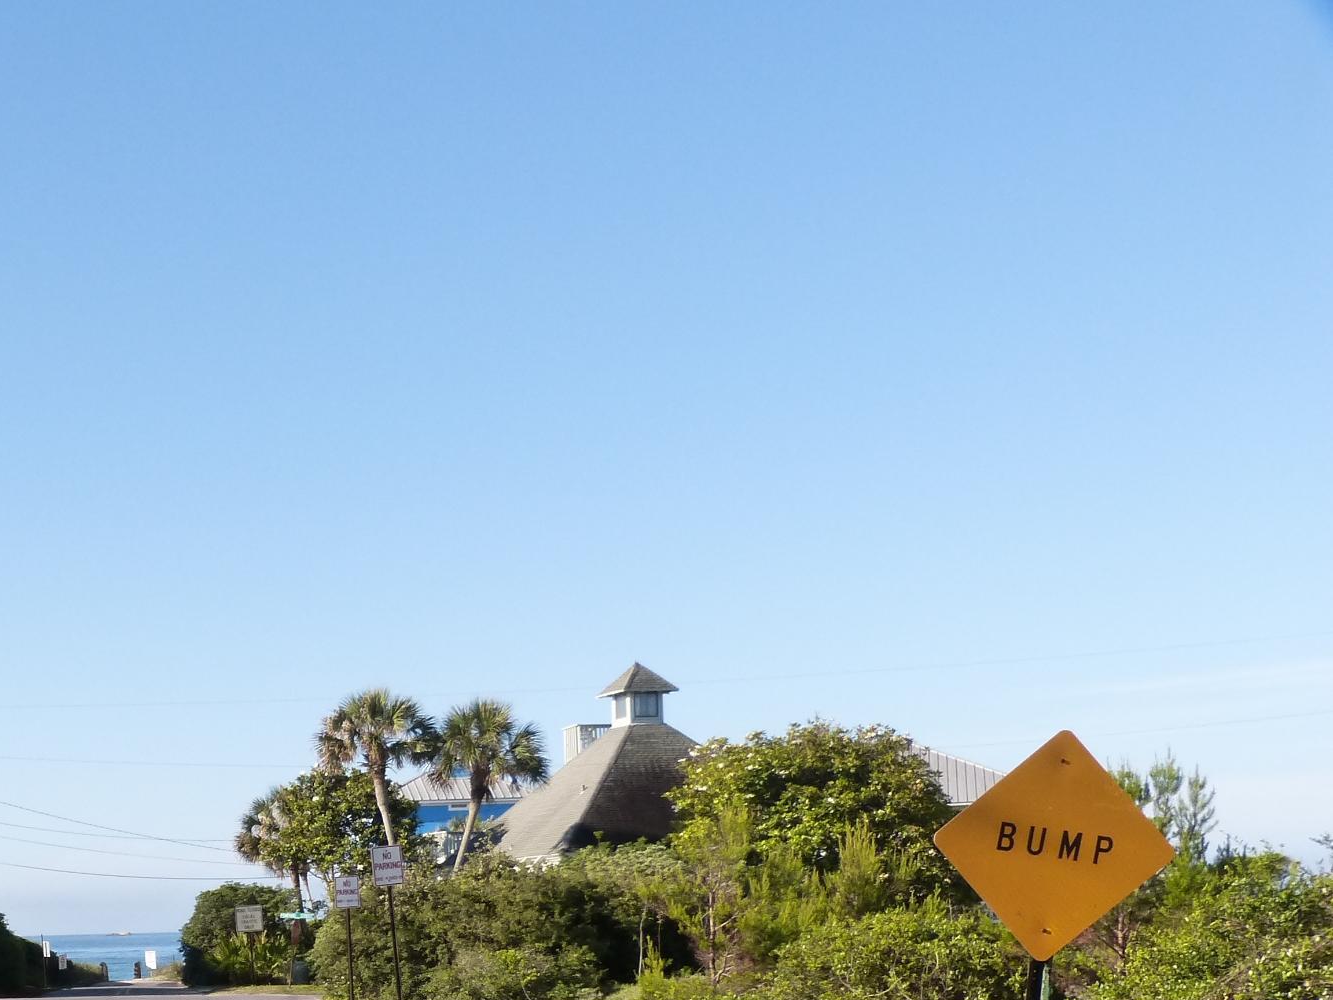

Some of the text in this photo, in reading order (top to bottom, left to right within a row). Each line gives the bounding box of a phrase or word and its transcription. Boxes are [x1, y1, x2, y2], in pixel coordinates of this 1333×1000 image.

[996, 821, 1113, 865] BUMP
[382, 851, 392, 861] NO
[374, 860, 402, 870] PARKING
[342, 879, 352, 888] NO
